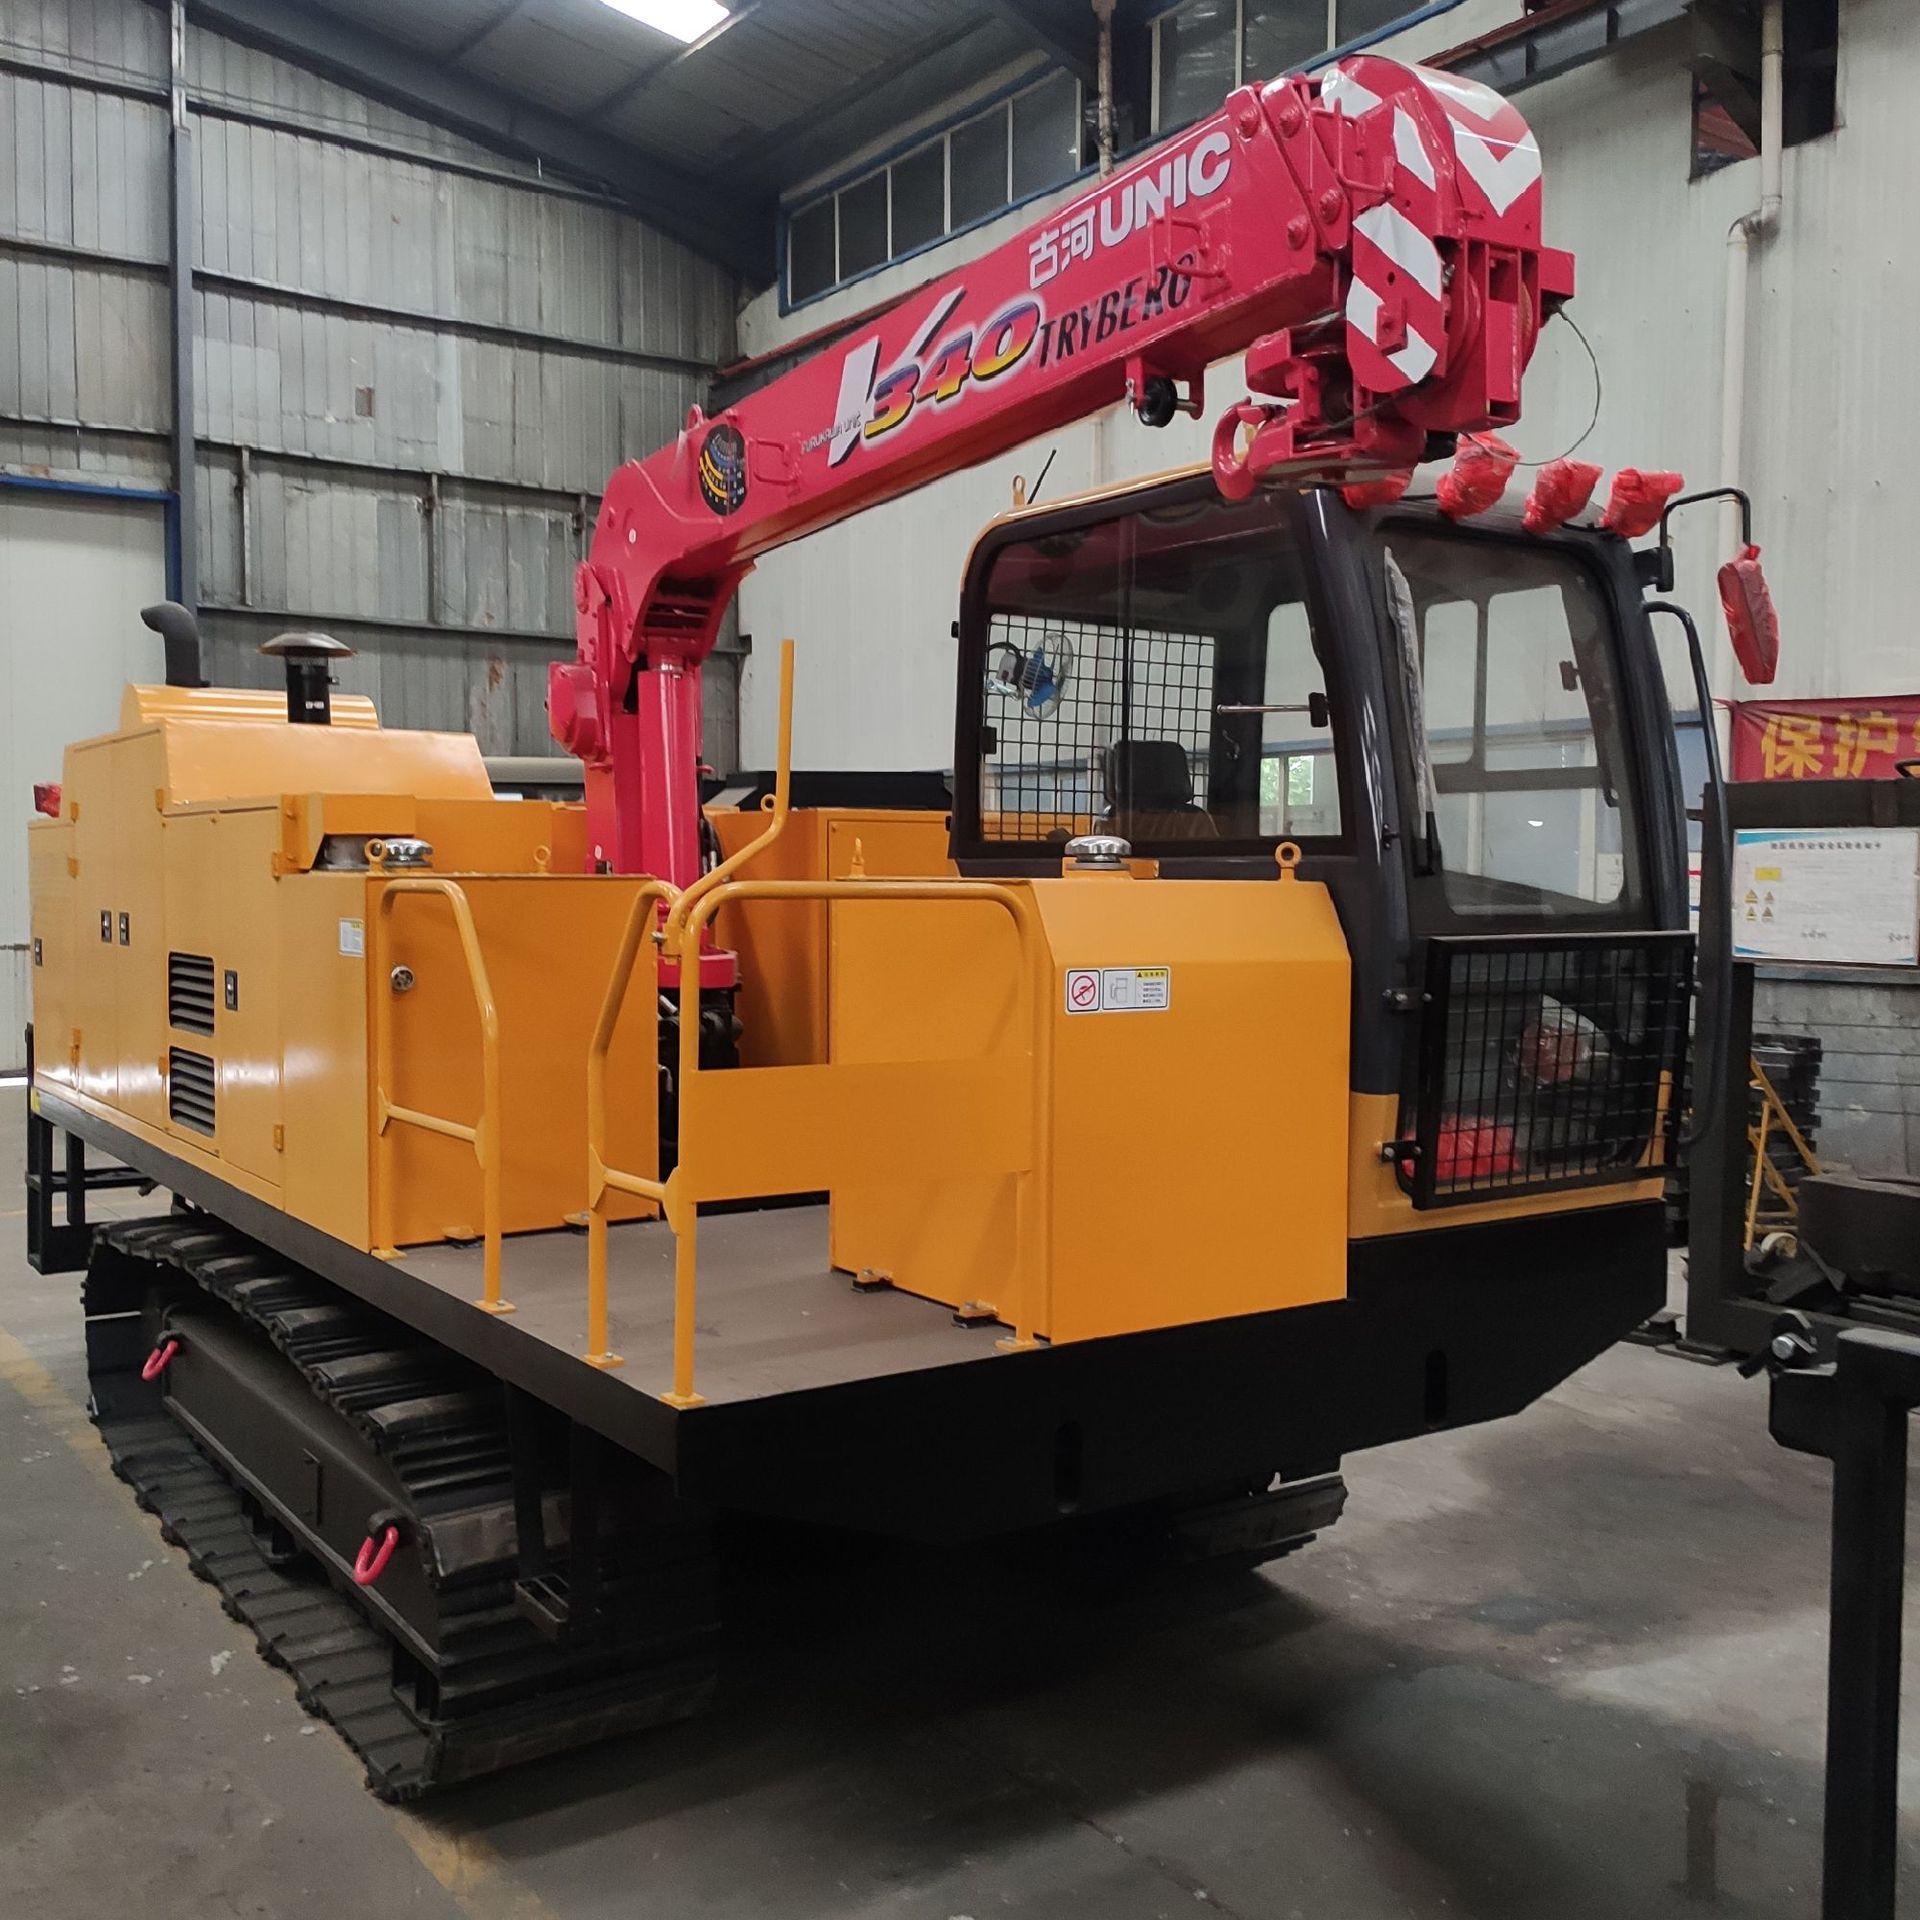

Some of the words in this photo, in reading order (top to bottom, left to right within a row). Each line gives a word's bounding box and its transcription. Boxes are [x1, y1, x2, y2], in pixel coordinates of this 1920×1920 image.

[1029, 205, 1096, 290] 古河
[1100, 131, 1231, 248] UNIC
[1039, 252, 1197, 368] TRYBERO
[1761, 710, 1920, 779] 保护
